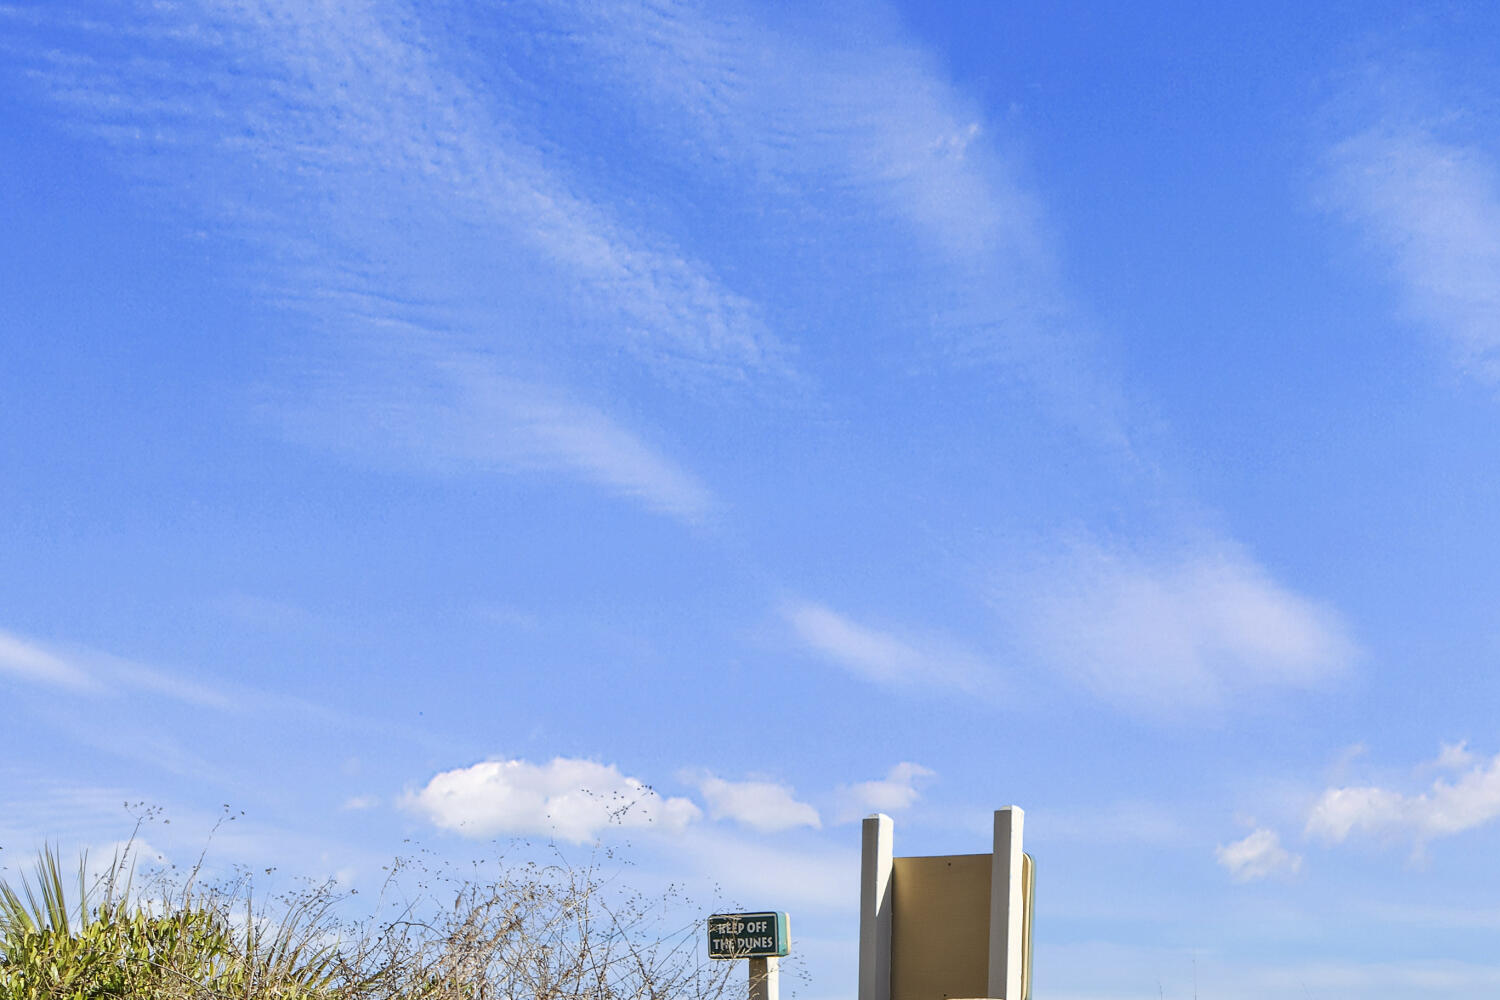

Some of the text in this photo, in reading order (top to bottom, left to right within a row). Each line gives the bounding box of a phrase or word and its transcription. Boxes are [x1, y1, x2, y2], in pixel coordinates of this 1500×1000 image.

[747, 921, 767, 933] OFF
[713, 936, 773, 950] THE DUNES
